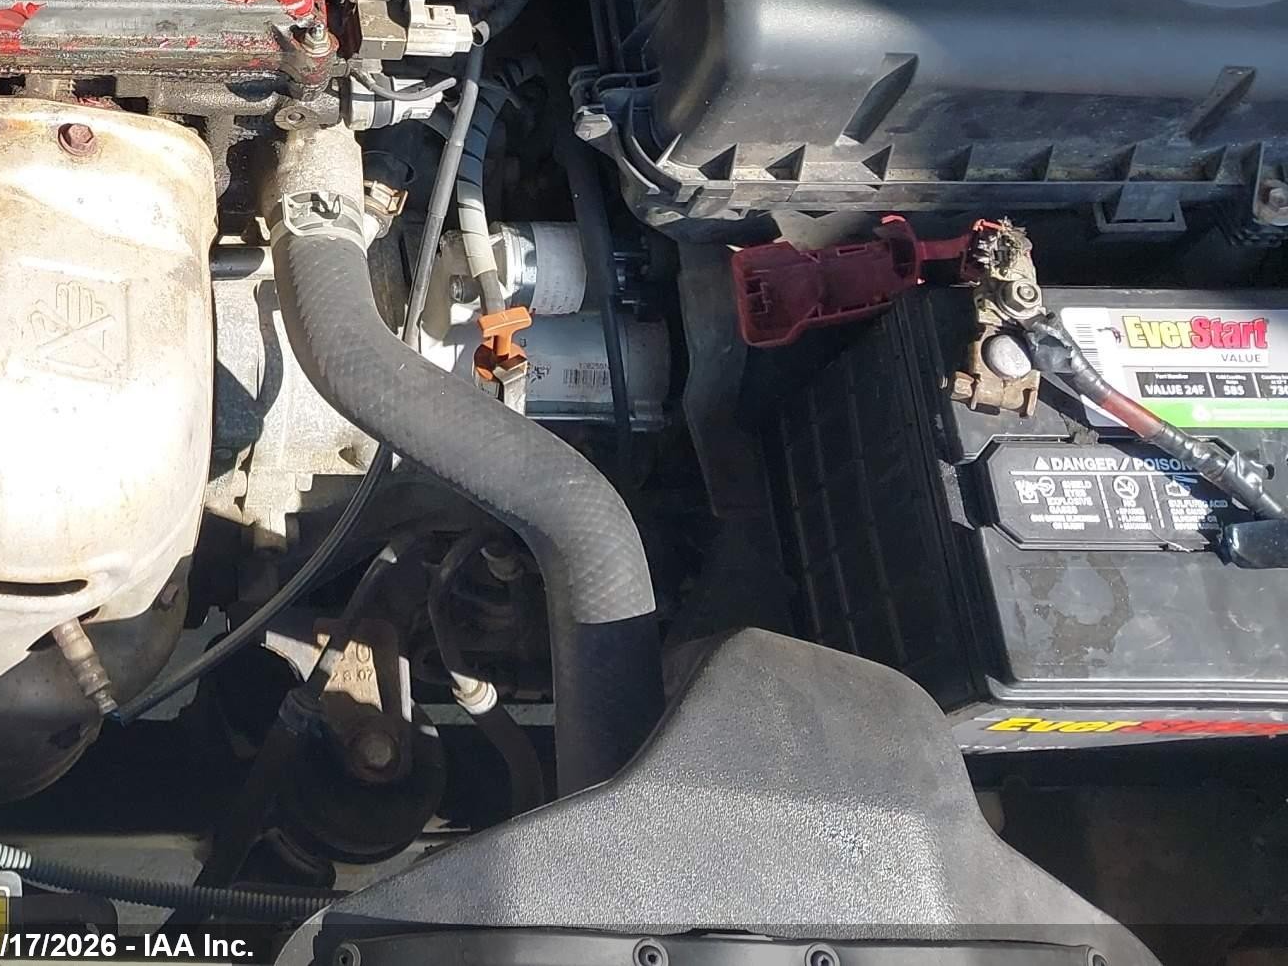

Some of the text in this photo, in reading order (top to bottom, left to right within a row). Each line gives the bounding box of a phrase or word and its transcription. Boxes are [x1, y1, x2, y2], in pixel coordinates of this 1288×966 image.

[1122, 315, 1268, 349] EverStart
[1221, 353, 1262, 363] VALUE
[1145, 385, 1206, 396] VALUE 24F
[1223, 385, 1245, 396] 585
[1050, 457, 1119, 470] DANGER
